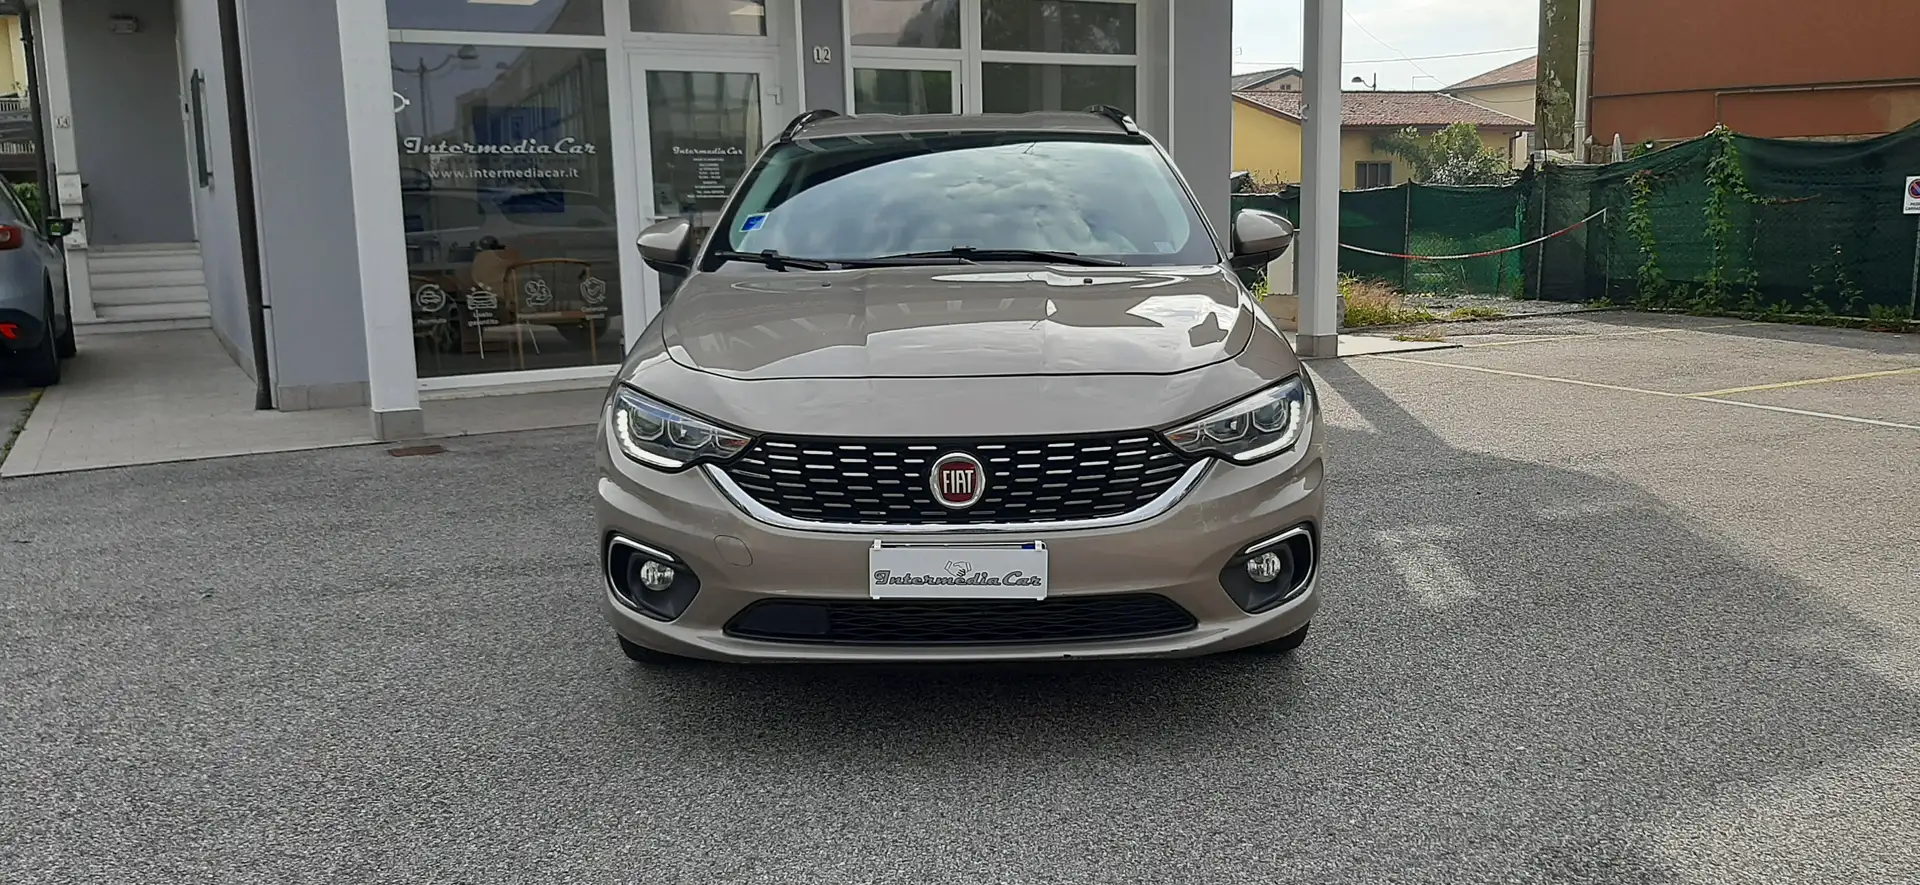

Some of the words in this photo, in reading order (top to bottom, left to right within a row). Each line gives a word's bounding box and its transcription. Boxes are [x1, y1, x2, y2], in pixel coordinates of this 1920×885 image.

[816, 48, 830, 61] 12
[404, 136, 552, 154] Intermedia
[554, 137, 597, 154] Car
[672, 146, 726, 155] Intermedia
[727, 146, 743, 155] Car
[429, 168, 579, 179] www.intermediacar.it
[942, 469, 974, 494] FIAT
[873, 569, 1001, 587] Intermedia
[1001, 570, 1042, 587] Car
